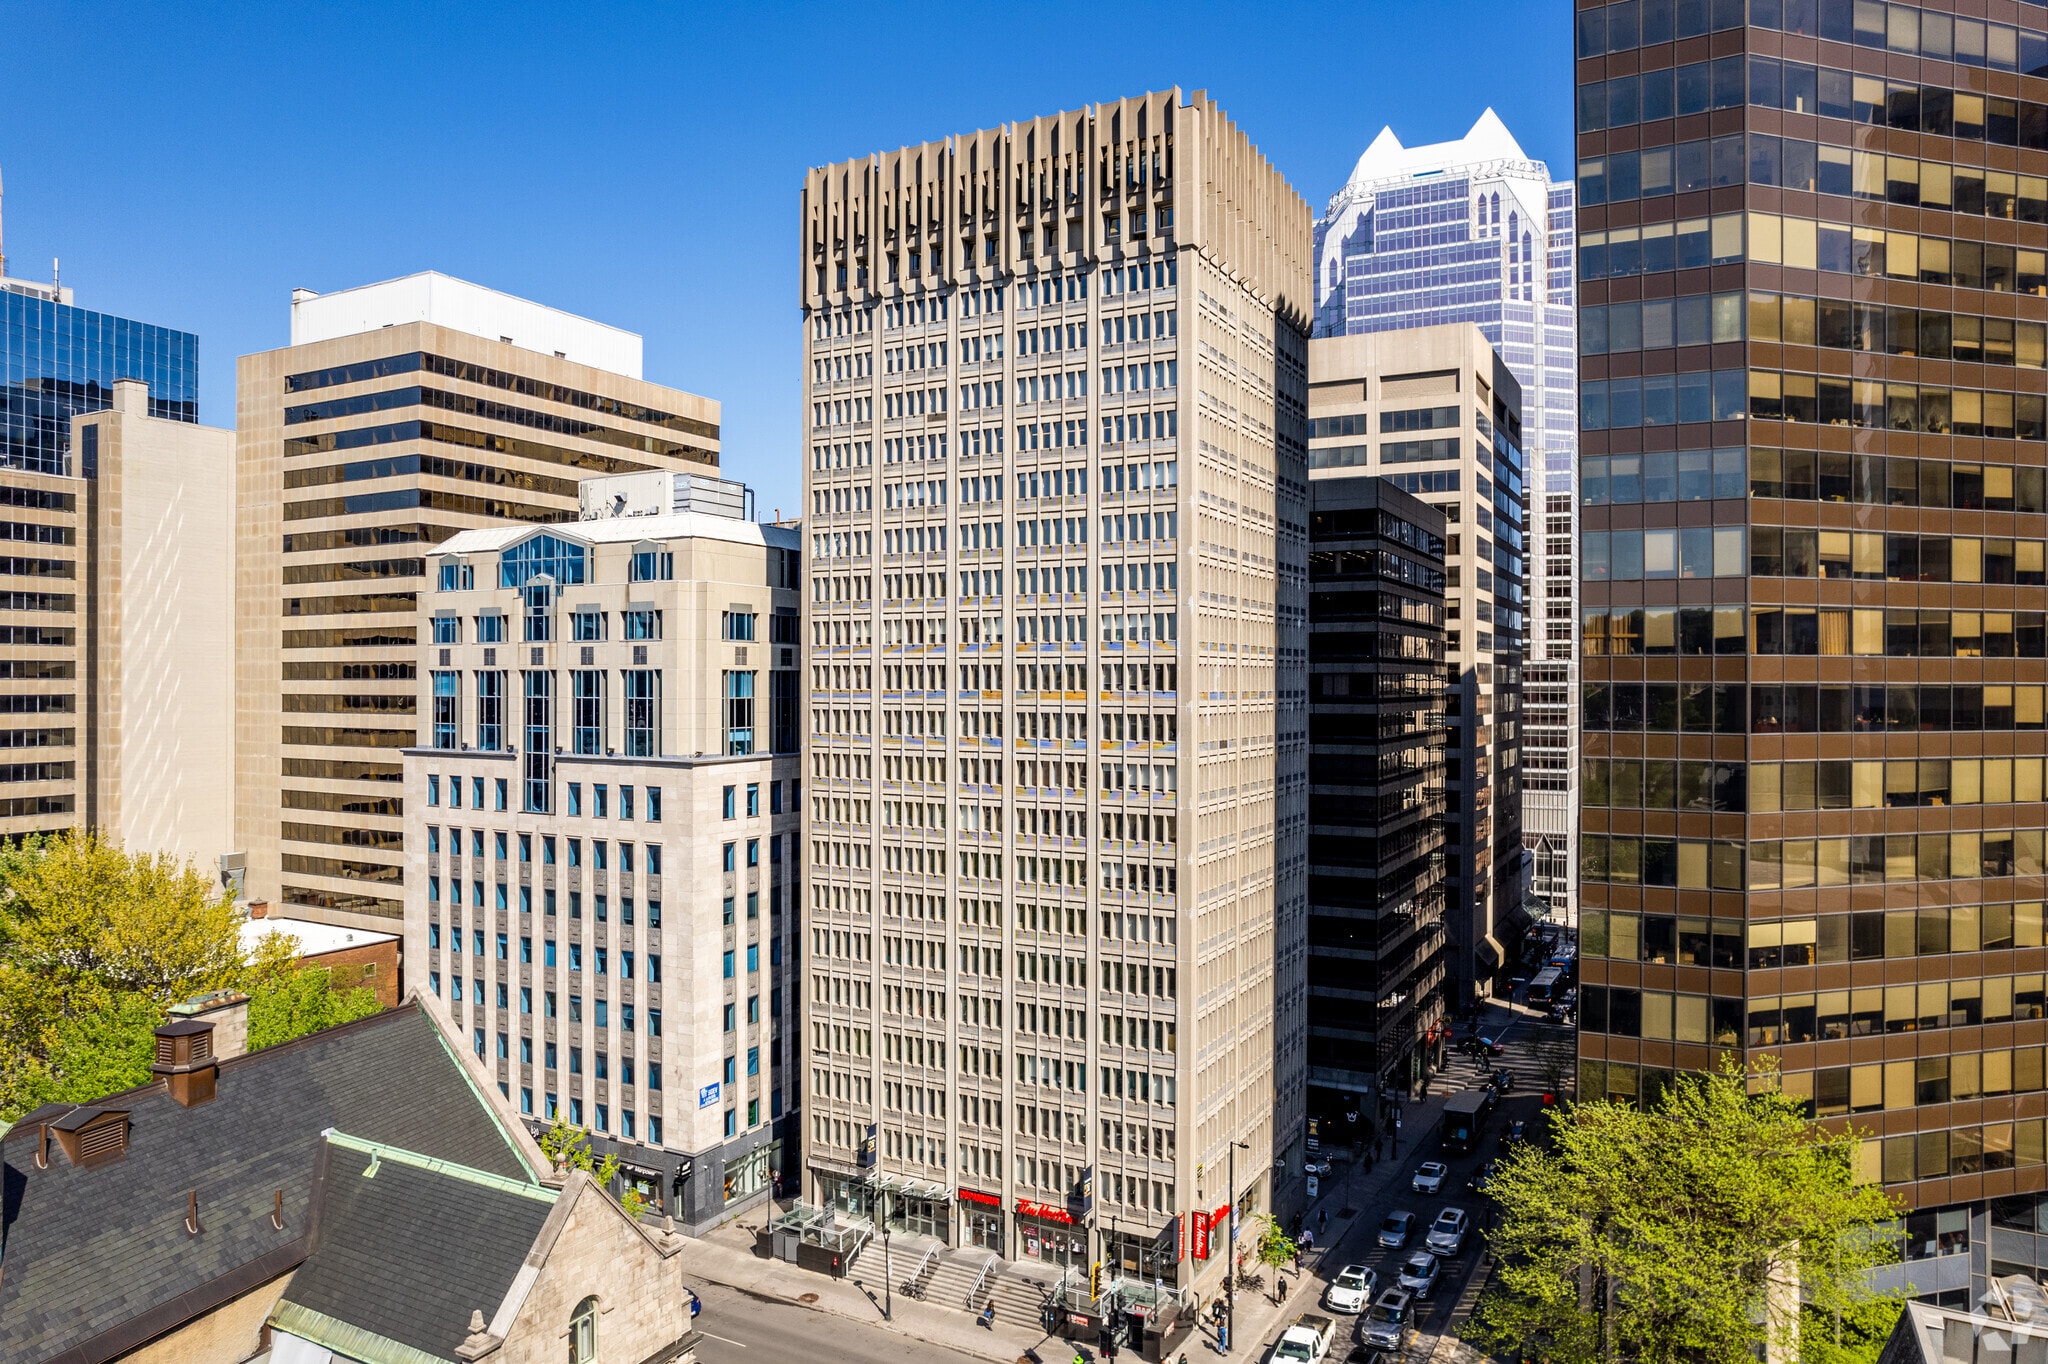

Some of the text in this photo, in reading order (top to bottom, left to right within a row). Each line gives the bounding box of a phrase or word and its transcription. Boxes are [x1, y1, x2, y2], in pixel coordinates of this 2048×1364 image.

[1017, 1199, 1038, 1216] Tim
[1196, 1214, 1206, 1256] Tim Hortons
